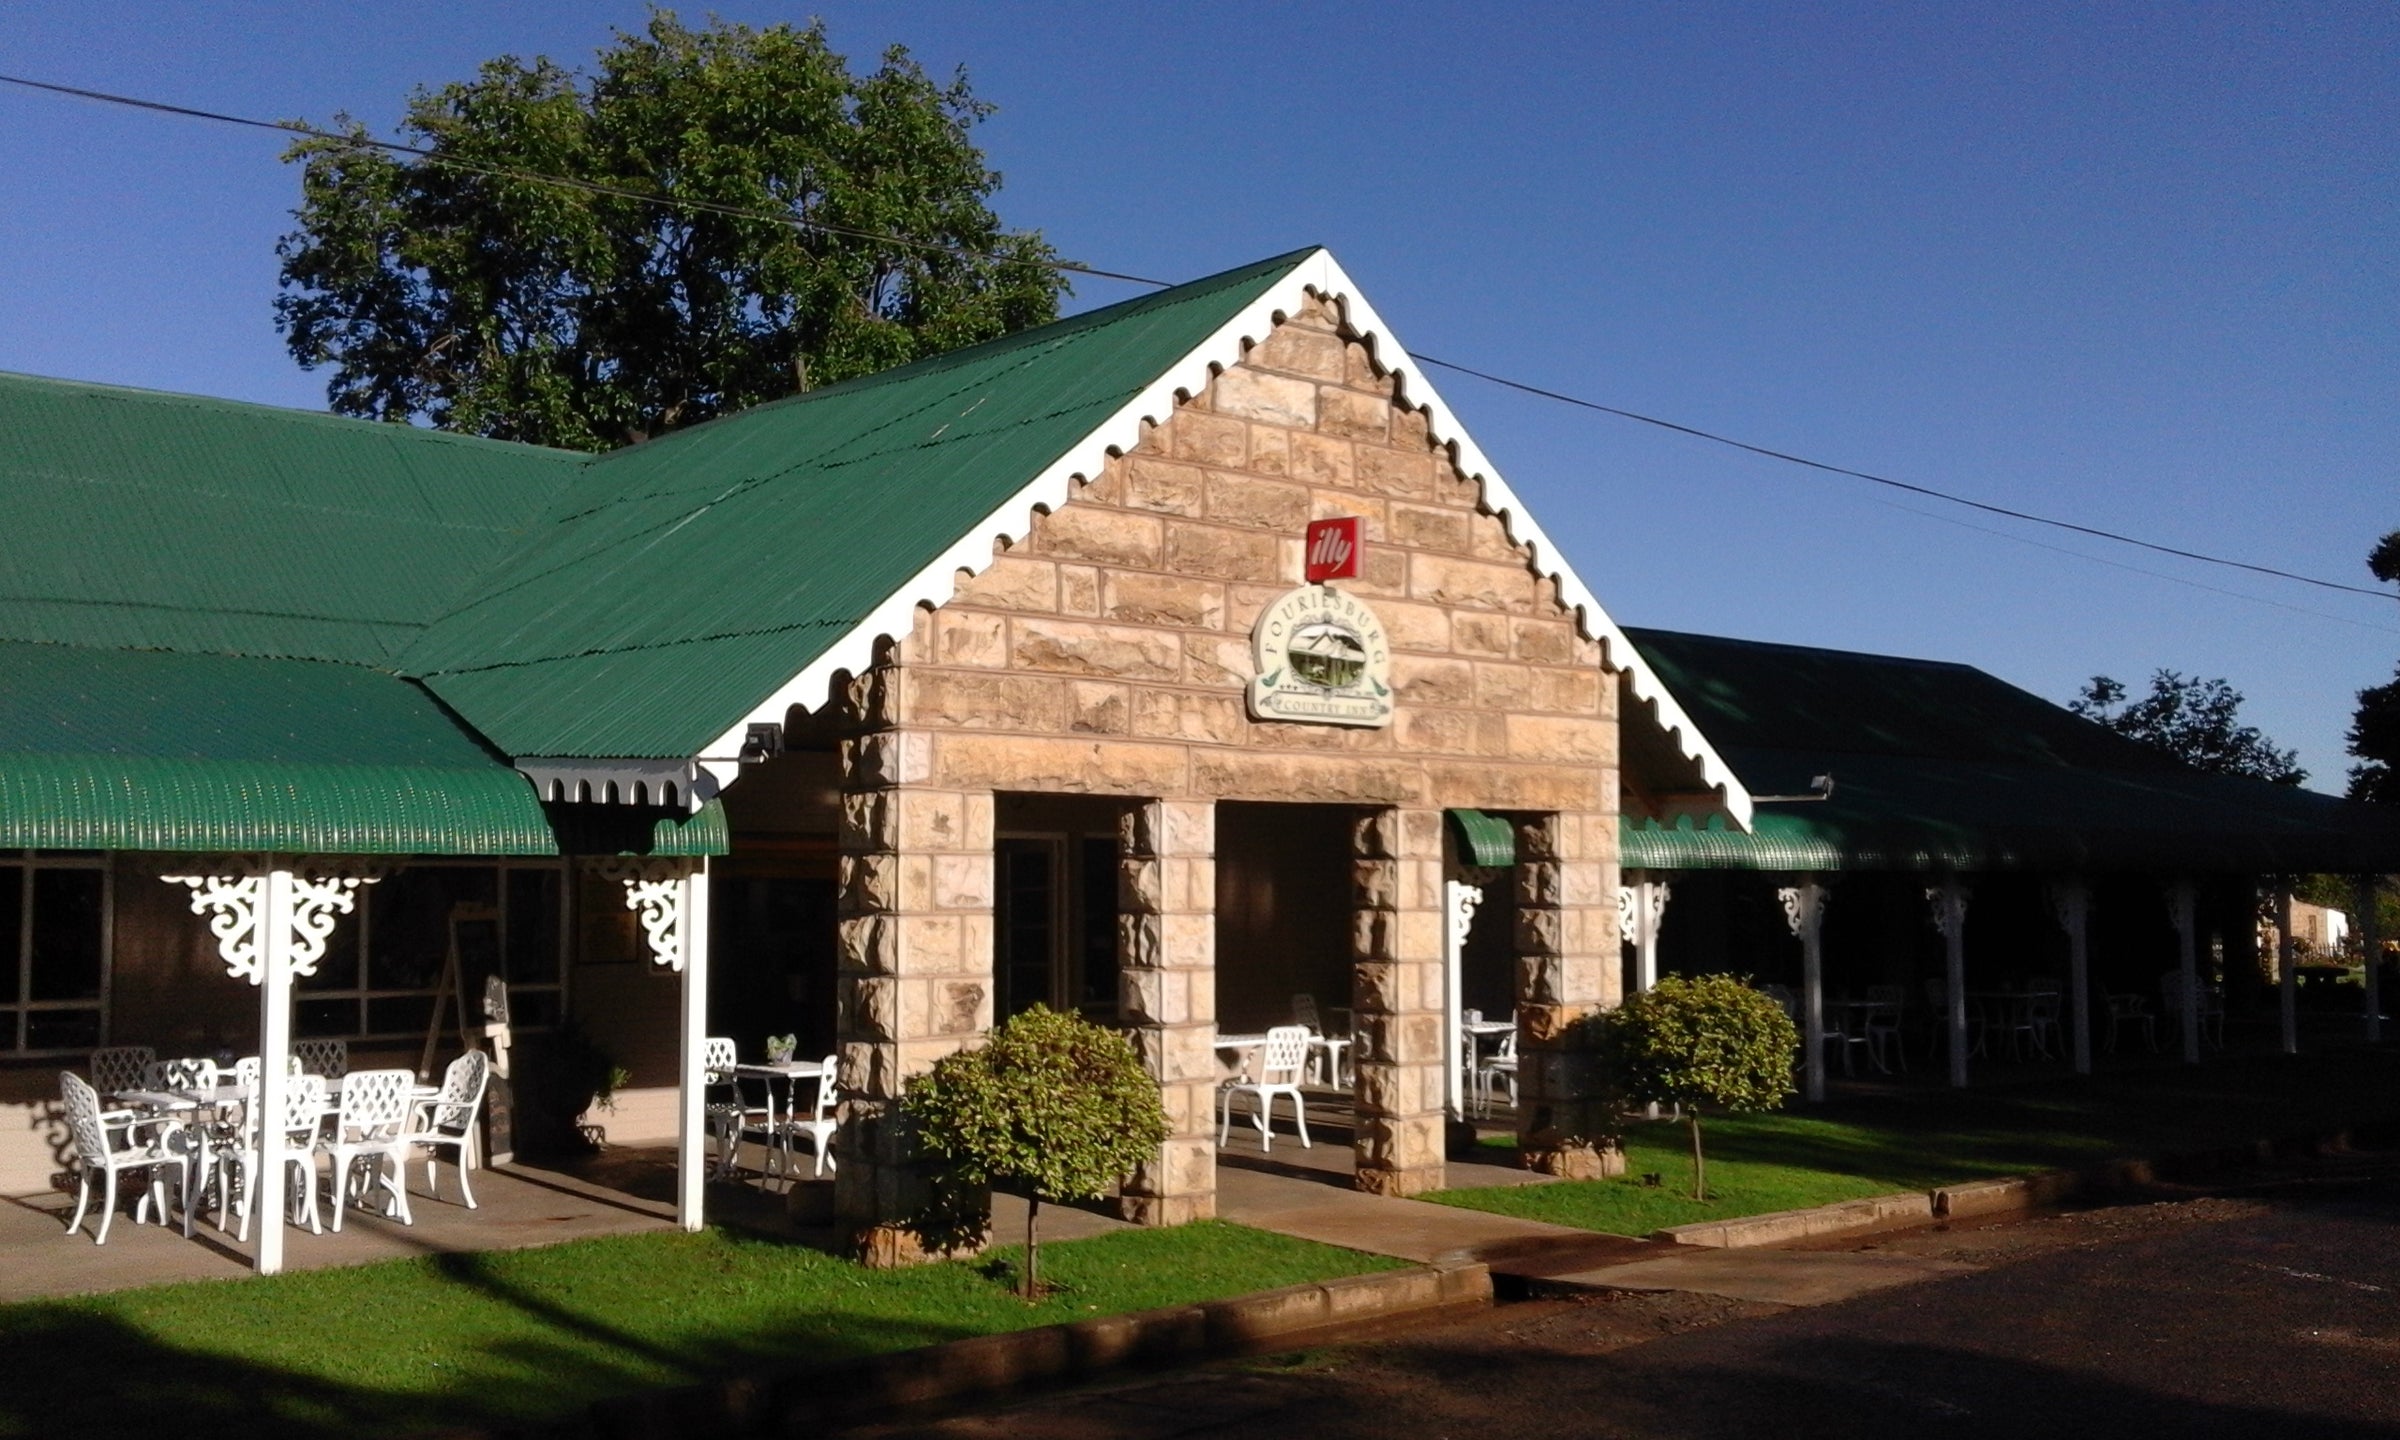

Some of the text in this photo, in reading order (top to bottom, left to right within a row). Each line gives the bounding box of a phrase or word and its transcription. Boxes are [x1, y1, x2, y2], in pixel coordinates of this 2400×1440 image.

[1312, 527, 1352, 573] illy
[1265, 592, 1386, 665] FOURIESBURG
[1284, 701, 1369, 715] COUNTRY INN
